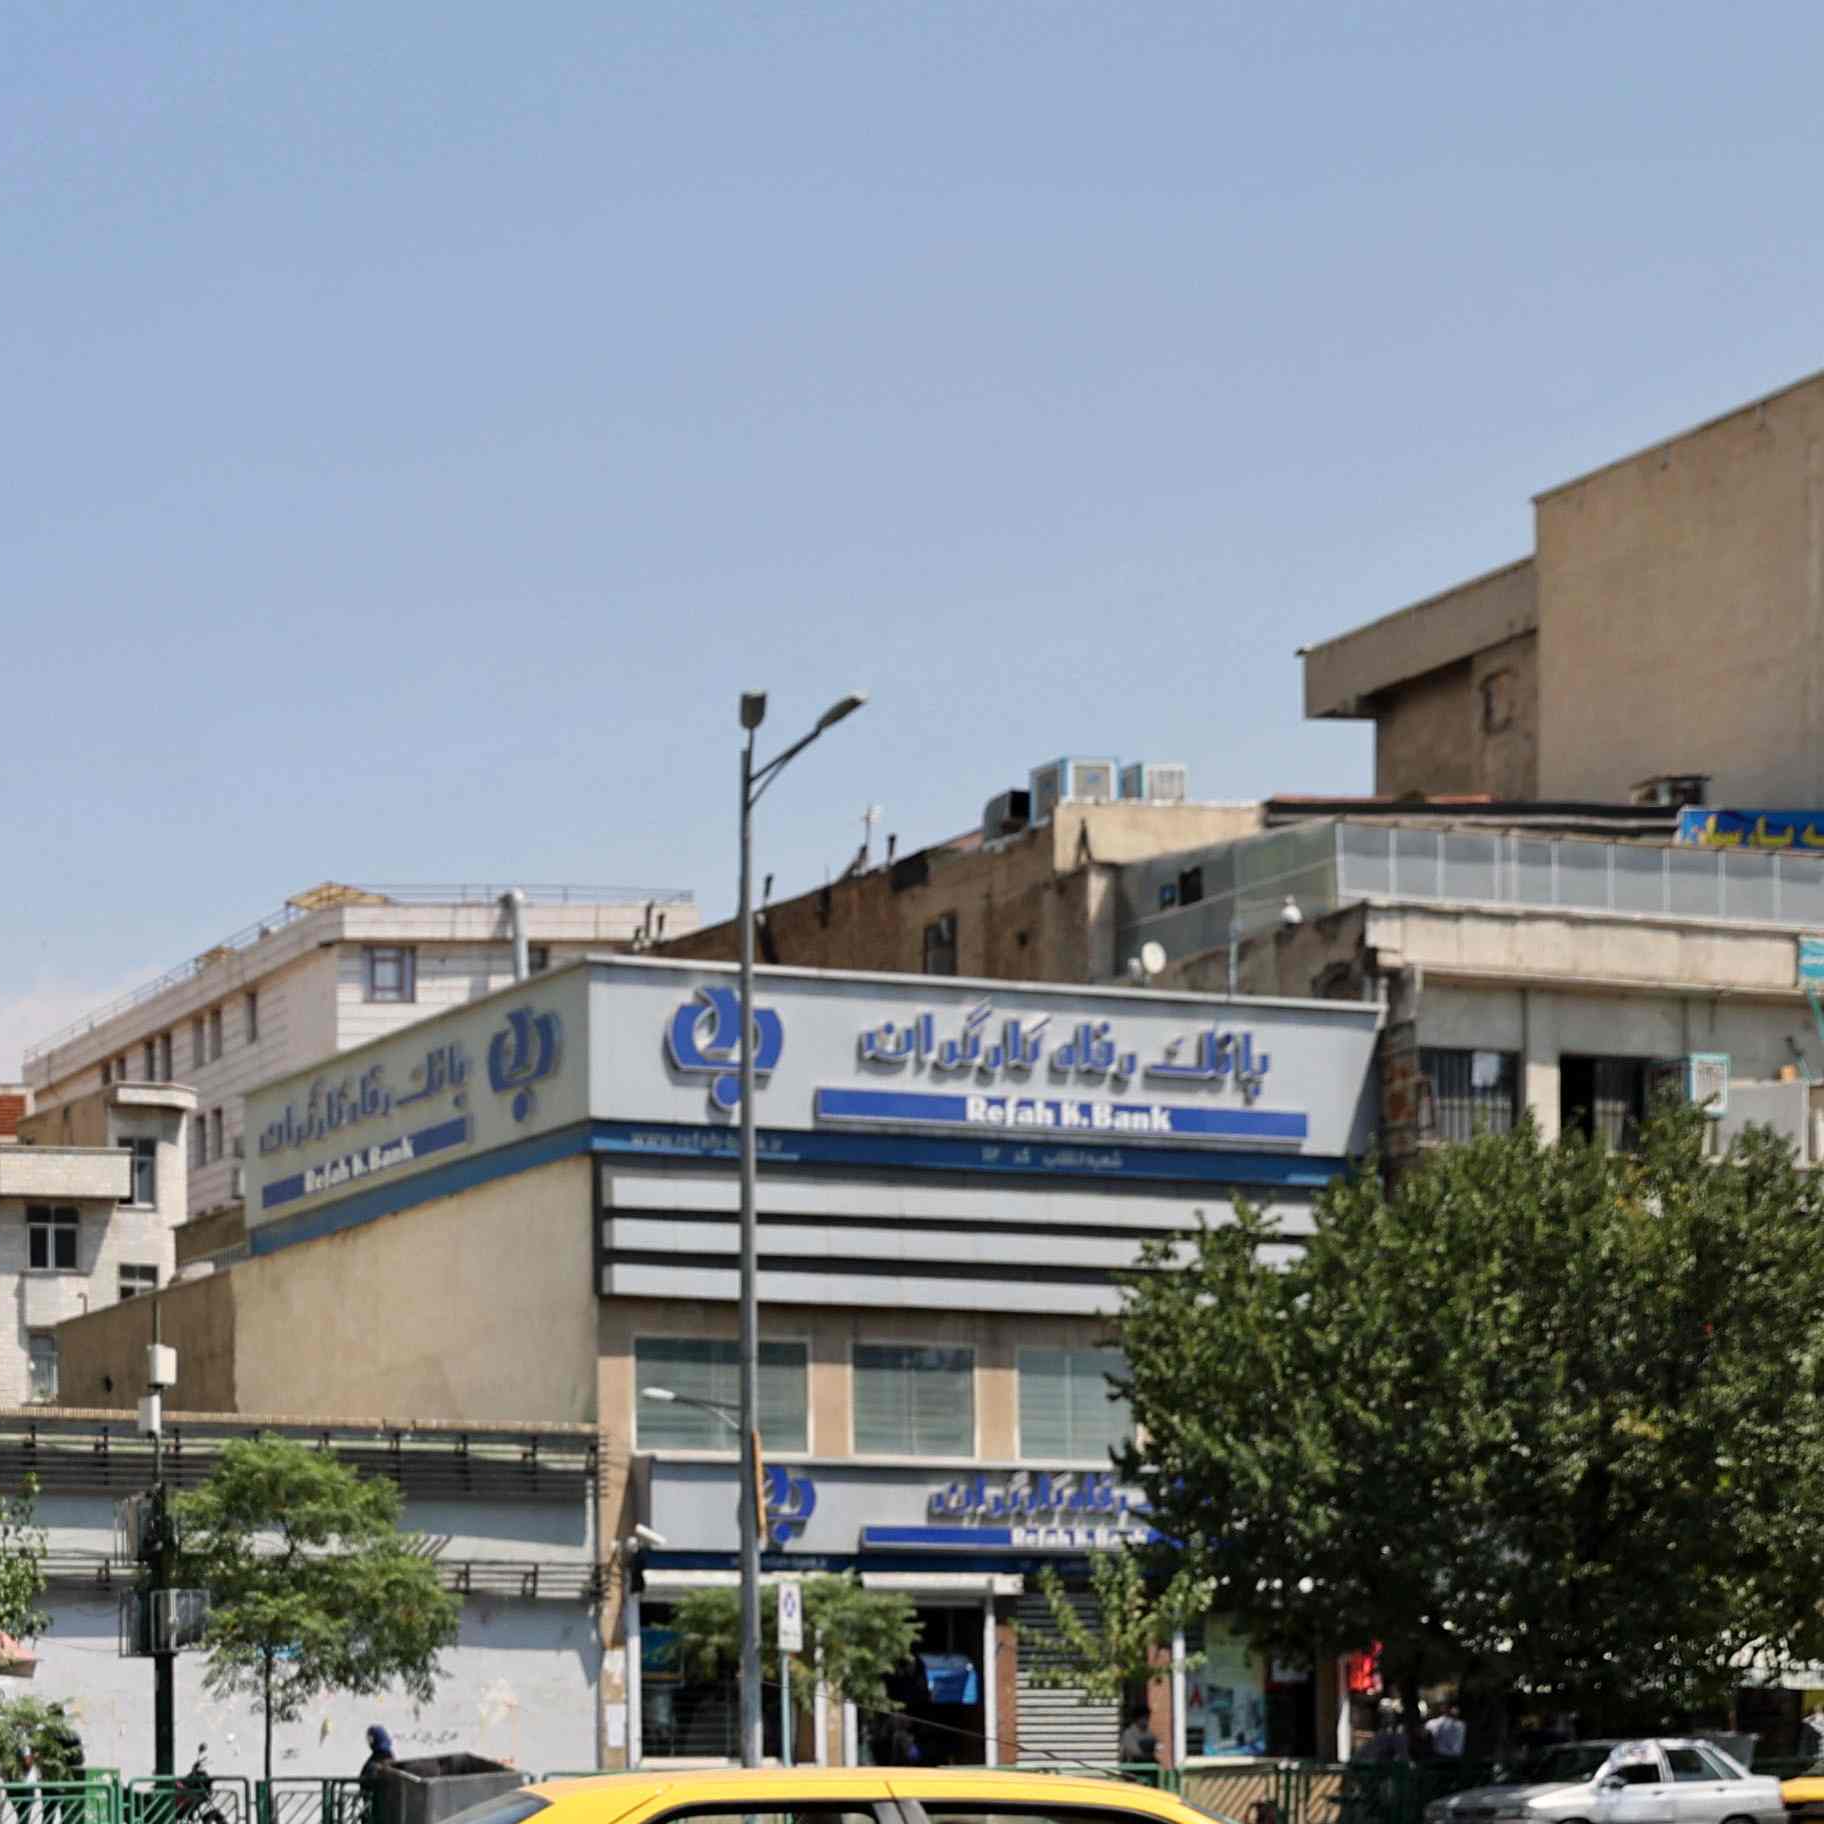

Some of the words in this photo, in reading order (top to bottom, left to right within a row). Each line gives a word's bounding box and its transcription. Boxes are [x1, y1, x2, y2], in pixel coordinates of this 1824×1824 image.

[863, 998, 1052, 1070] کارگران
[1054, 1022, 1137, 1077] رفاه
[965, 1095, 1057, 1129] Refah
